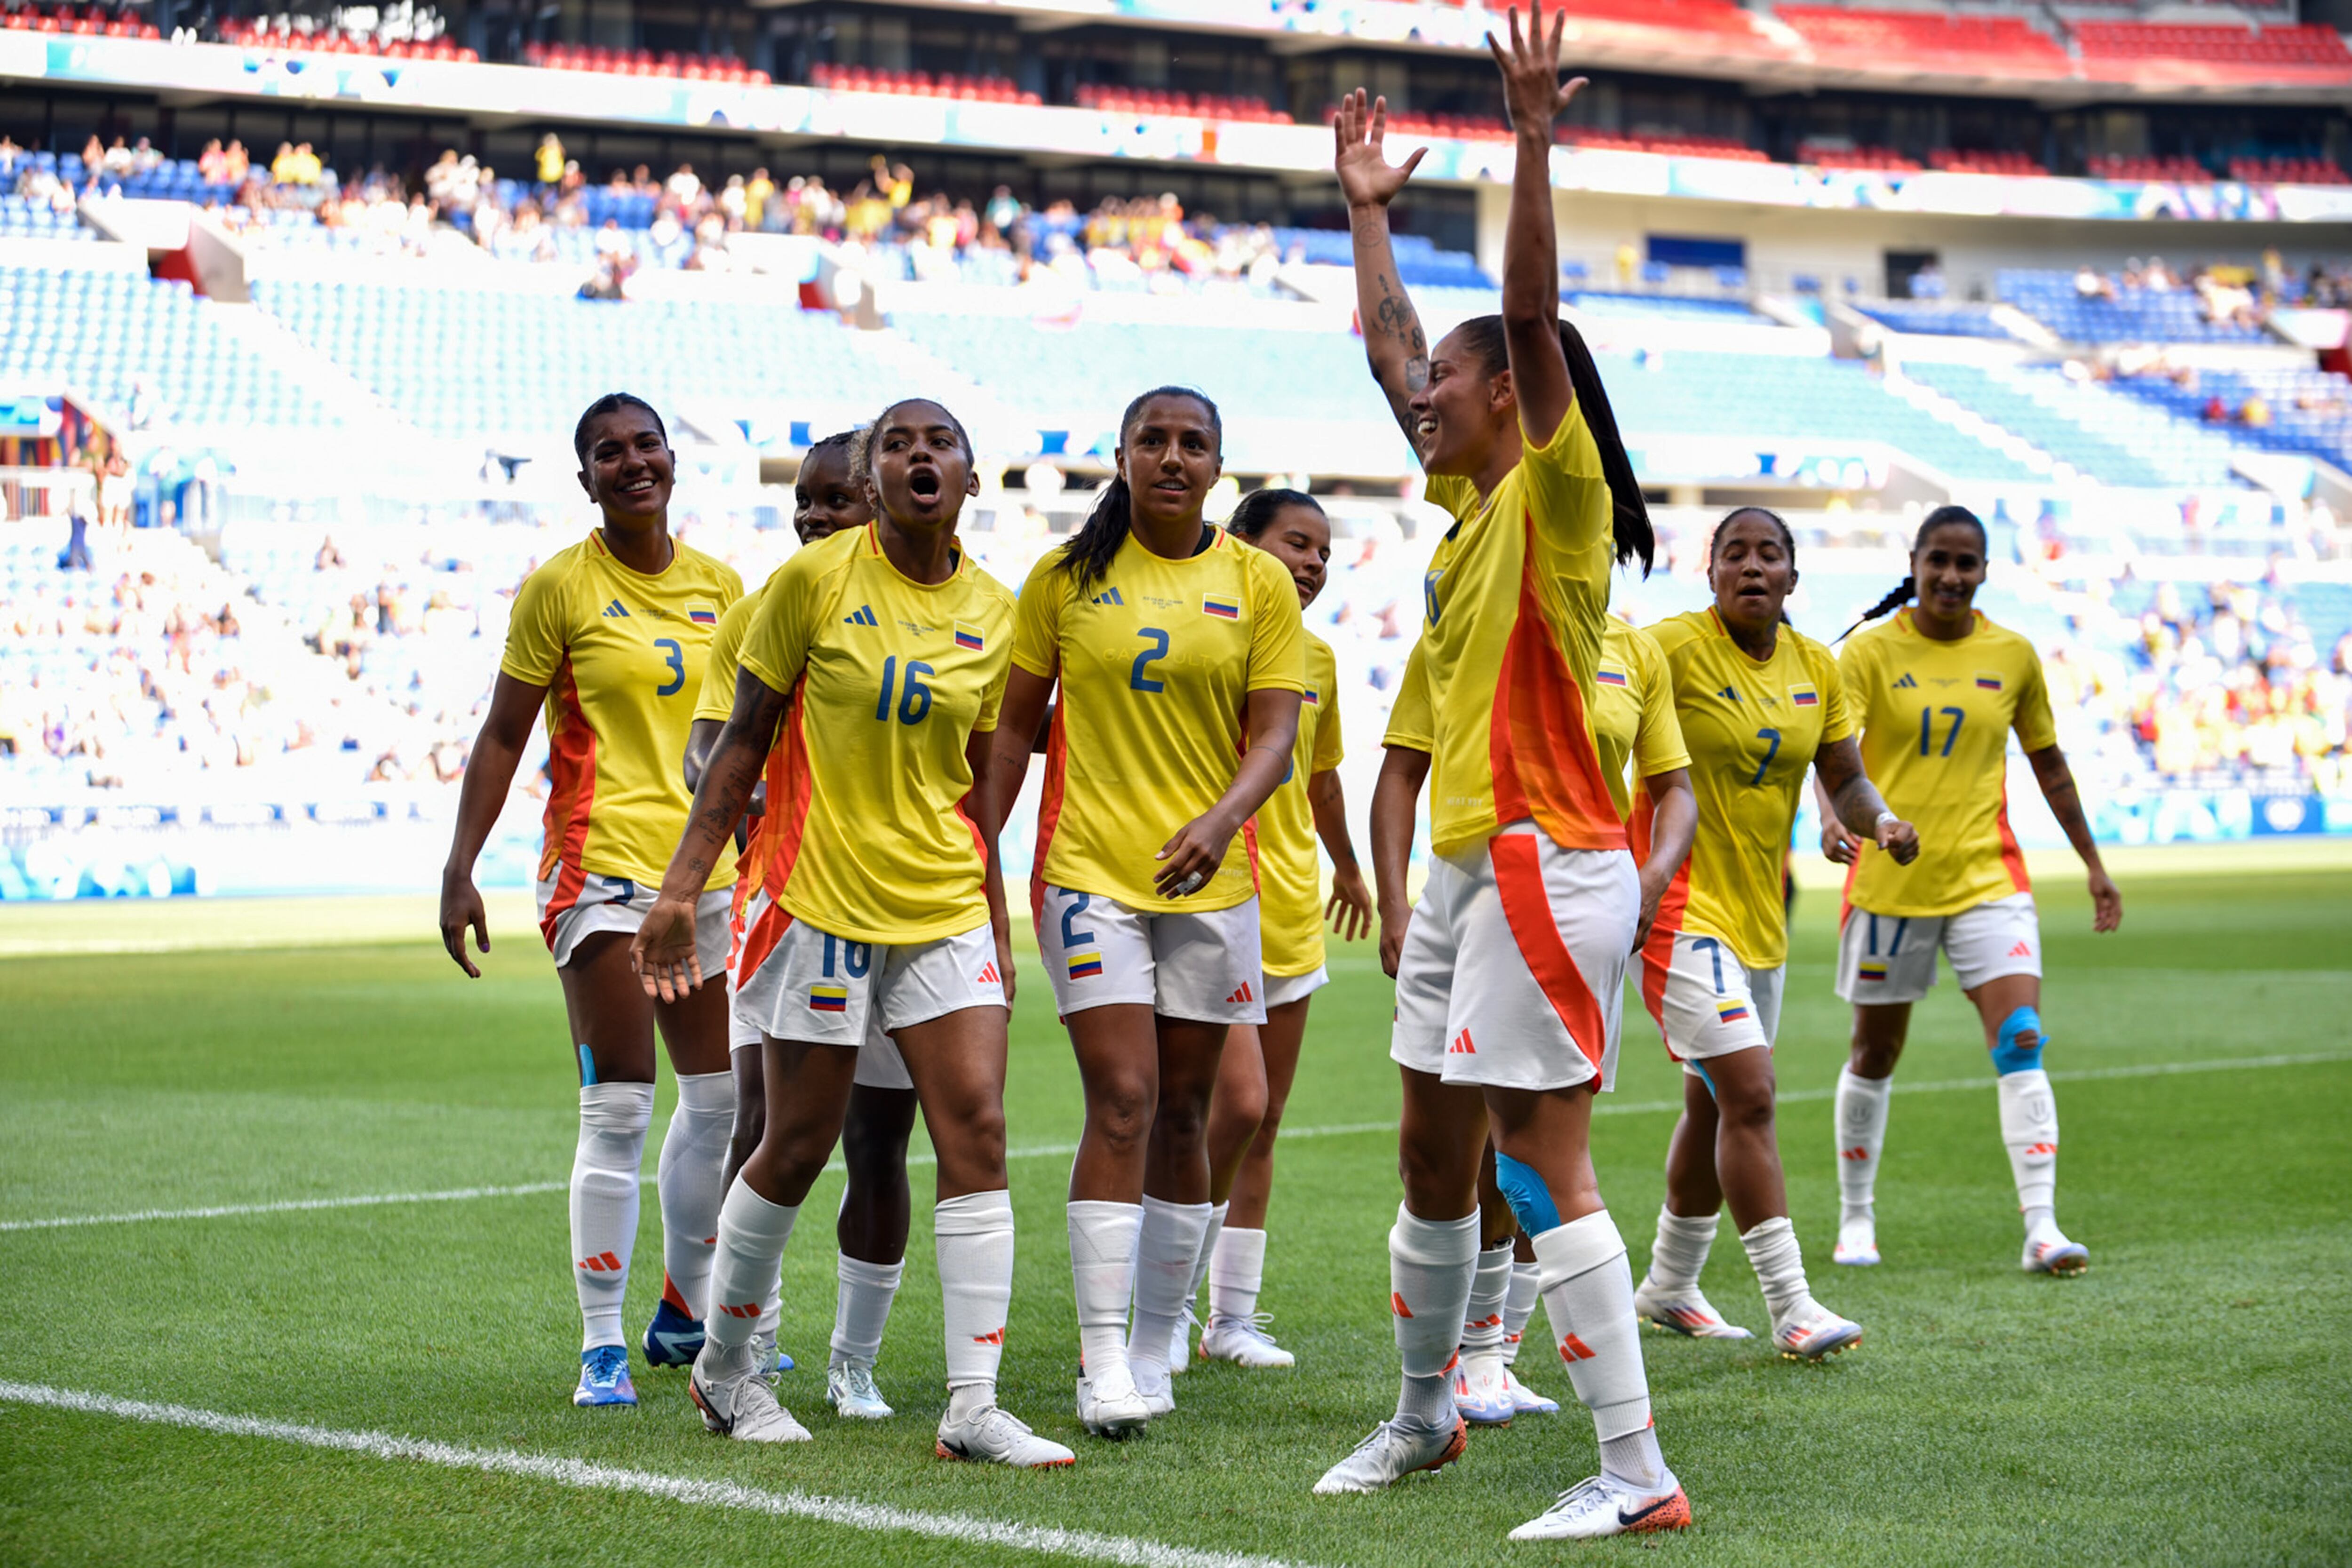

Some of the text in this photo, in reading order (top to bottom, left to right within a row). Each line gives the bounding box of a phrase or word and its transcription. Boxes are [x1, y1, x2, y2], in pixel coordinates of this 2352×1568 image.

[654, 638, 685, 695] 3
[1103, 648, 1210, 668] CATULT
[1130, 627, 1169, 693] 2
[876, 655, 935, 725] 16
[1752, 728, 1781, 785] 7
[1921, 706, 1964, 756] 17
[1058, 888, 1094, 948] 2
[1692, 938, 1725, 994] 7
